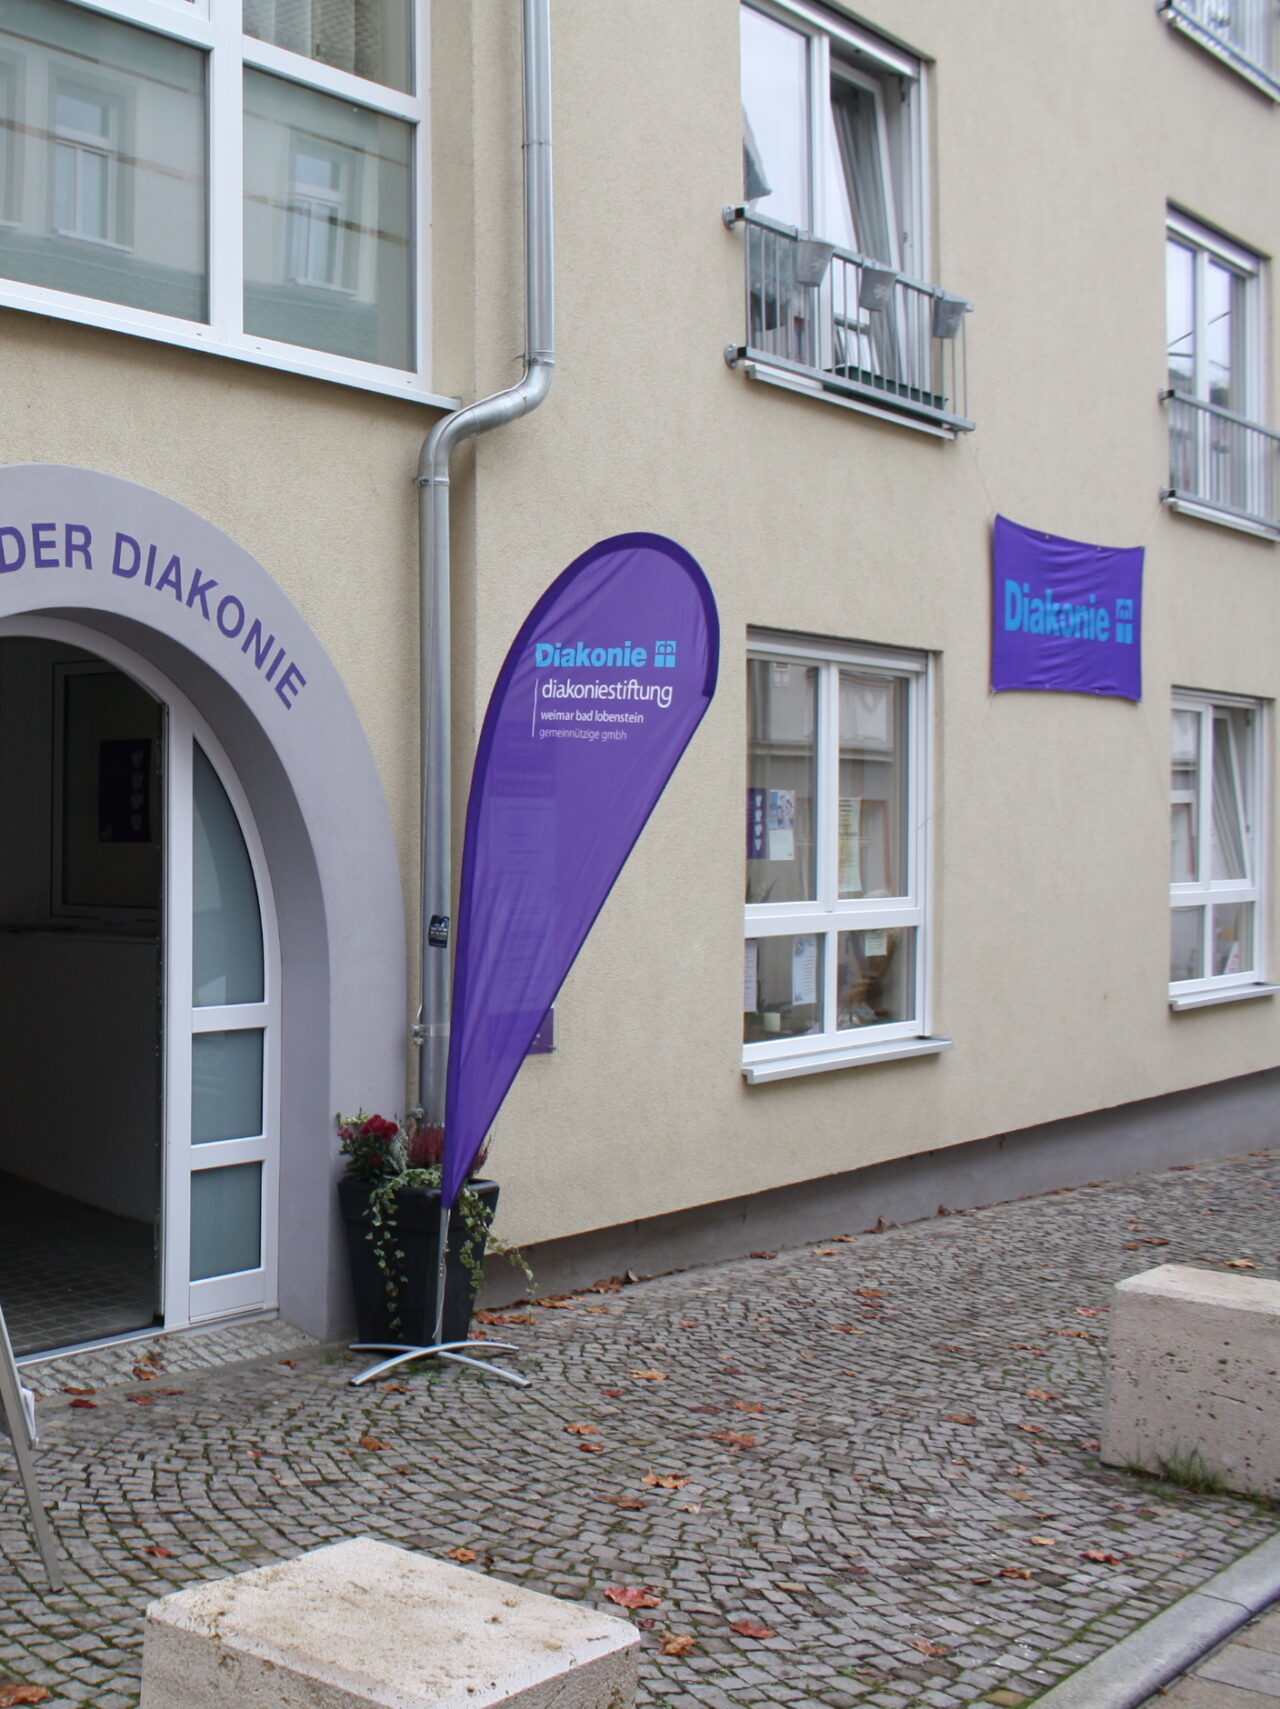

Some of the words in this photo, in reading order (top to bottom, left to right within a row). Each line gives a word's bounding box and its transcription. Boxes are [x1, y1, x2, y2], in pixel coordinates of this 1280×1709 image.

[111, 531, 307, 711] DIAKONIE
[1004, 578, 1111, 643] Diakonie
[535, 640, 648, 668] Diakonie
[542, 678, 673, 708] diakoniestiftung
[540, 709, 574, 721] weimar
[575, 709, 593, 722] bad
[594, 710, 644, 723] lobenstein
[539, 727, 600, 742] gemeinnützige
[601, 730, 627, 742] gmbh
